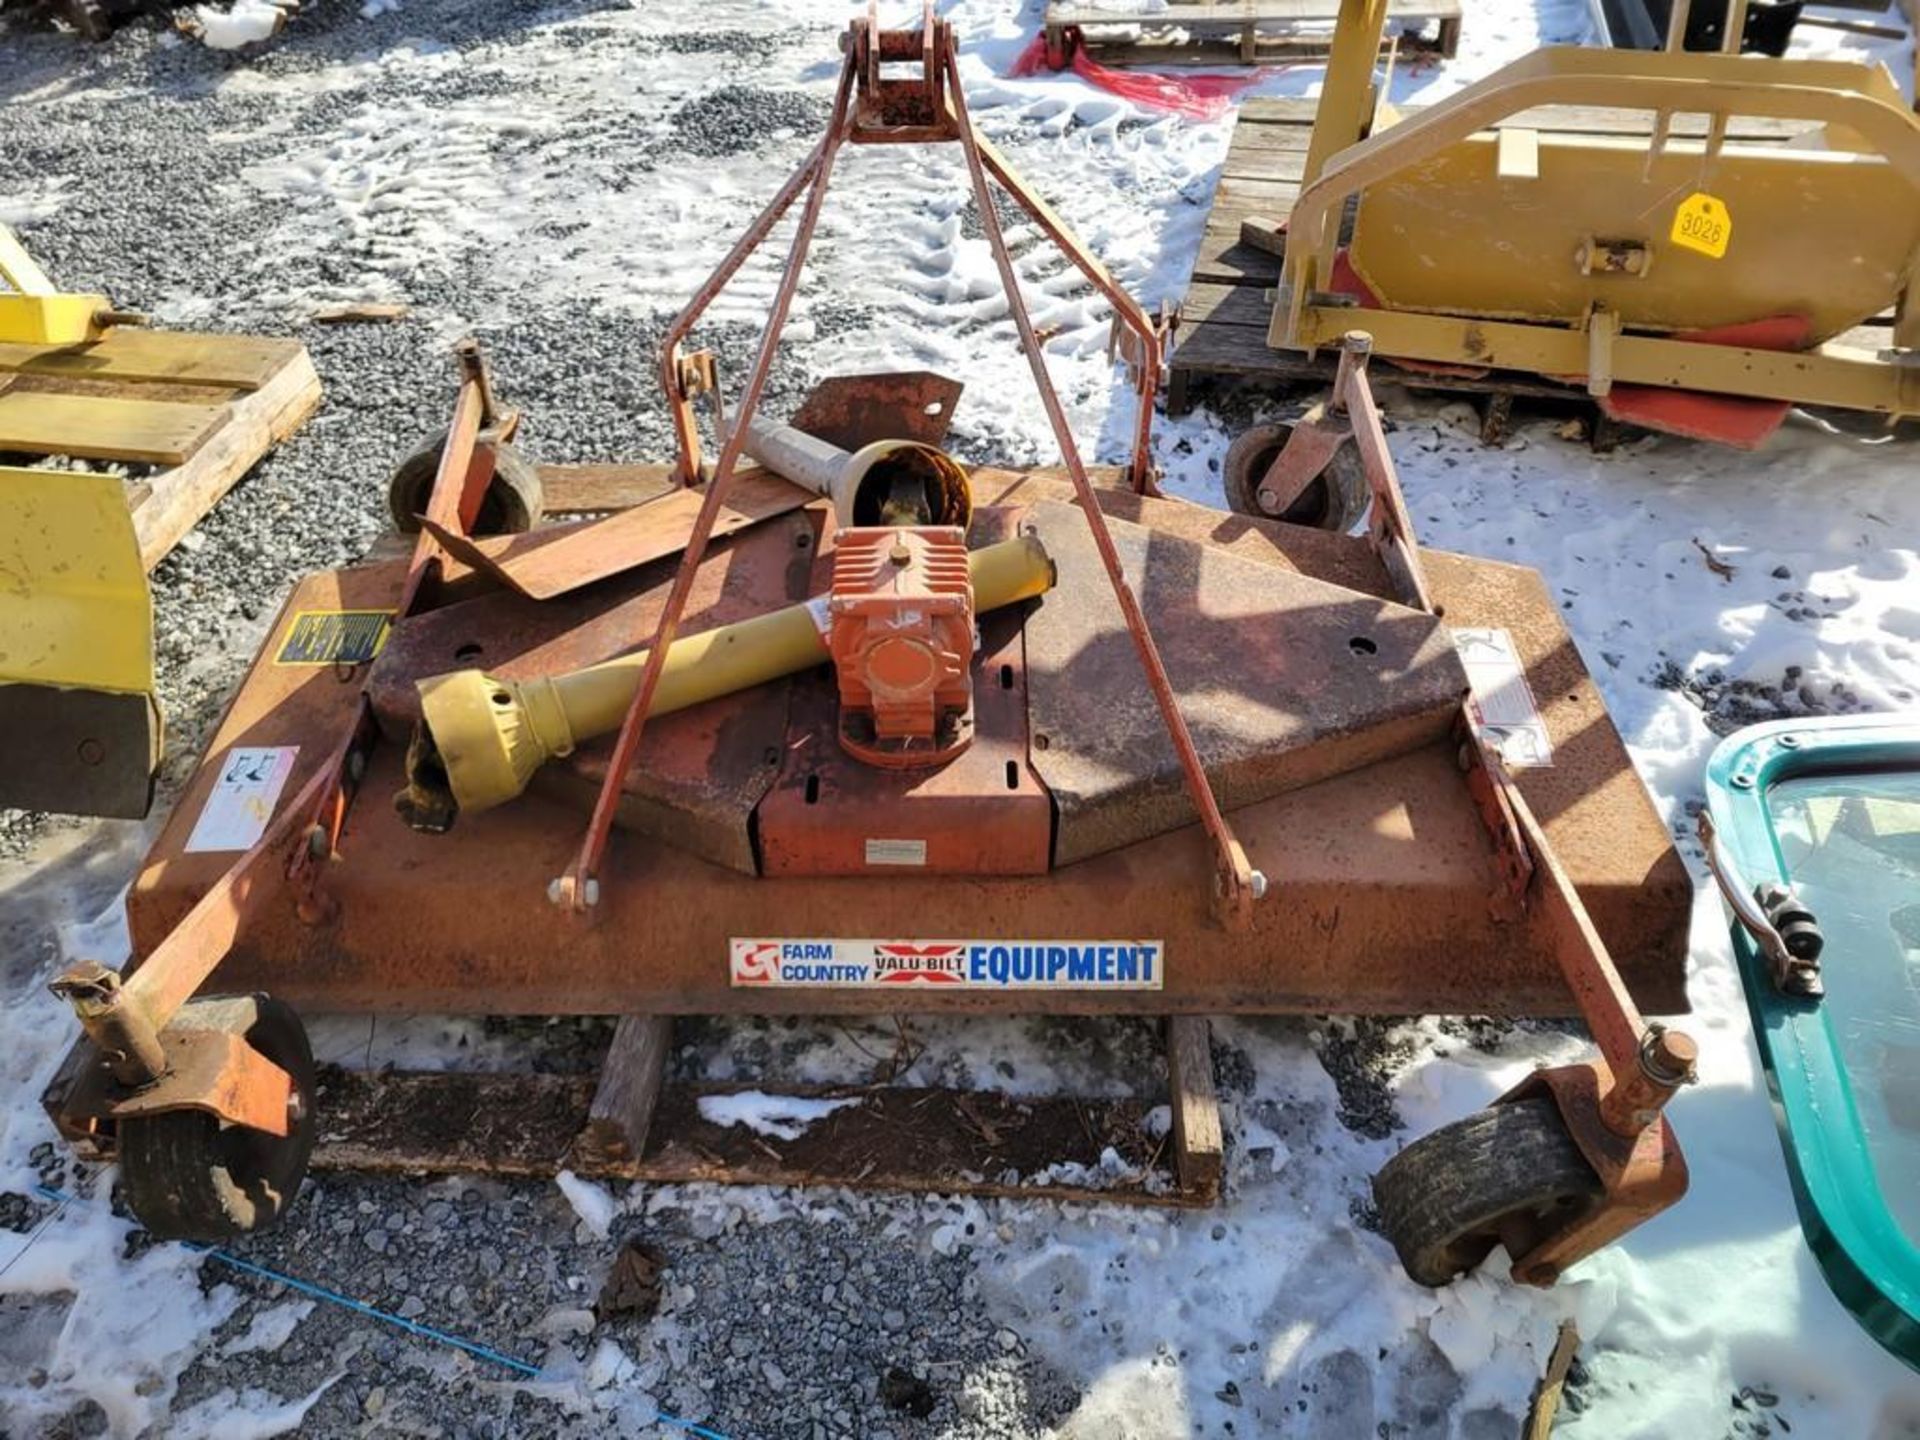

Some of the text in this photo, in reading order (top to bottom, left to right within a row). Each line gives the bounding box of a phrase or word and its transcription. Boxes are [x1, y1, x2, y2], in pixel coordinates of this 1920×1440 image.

[782, 944, 833, 960] FARM
[781, 964, 869, 981] COUNTRY
[970, 946, 1157, 984] EQUIPMENT
